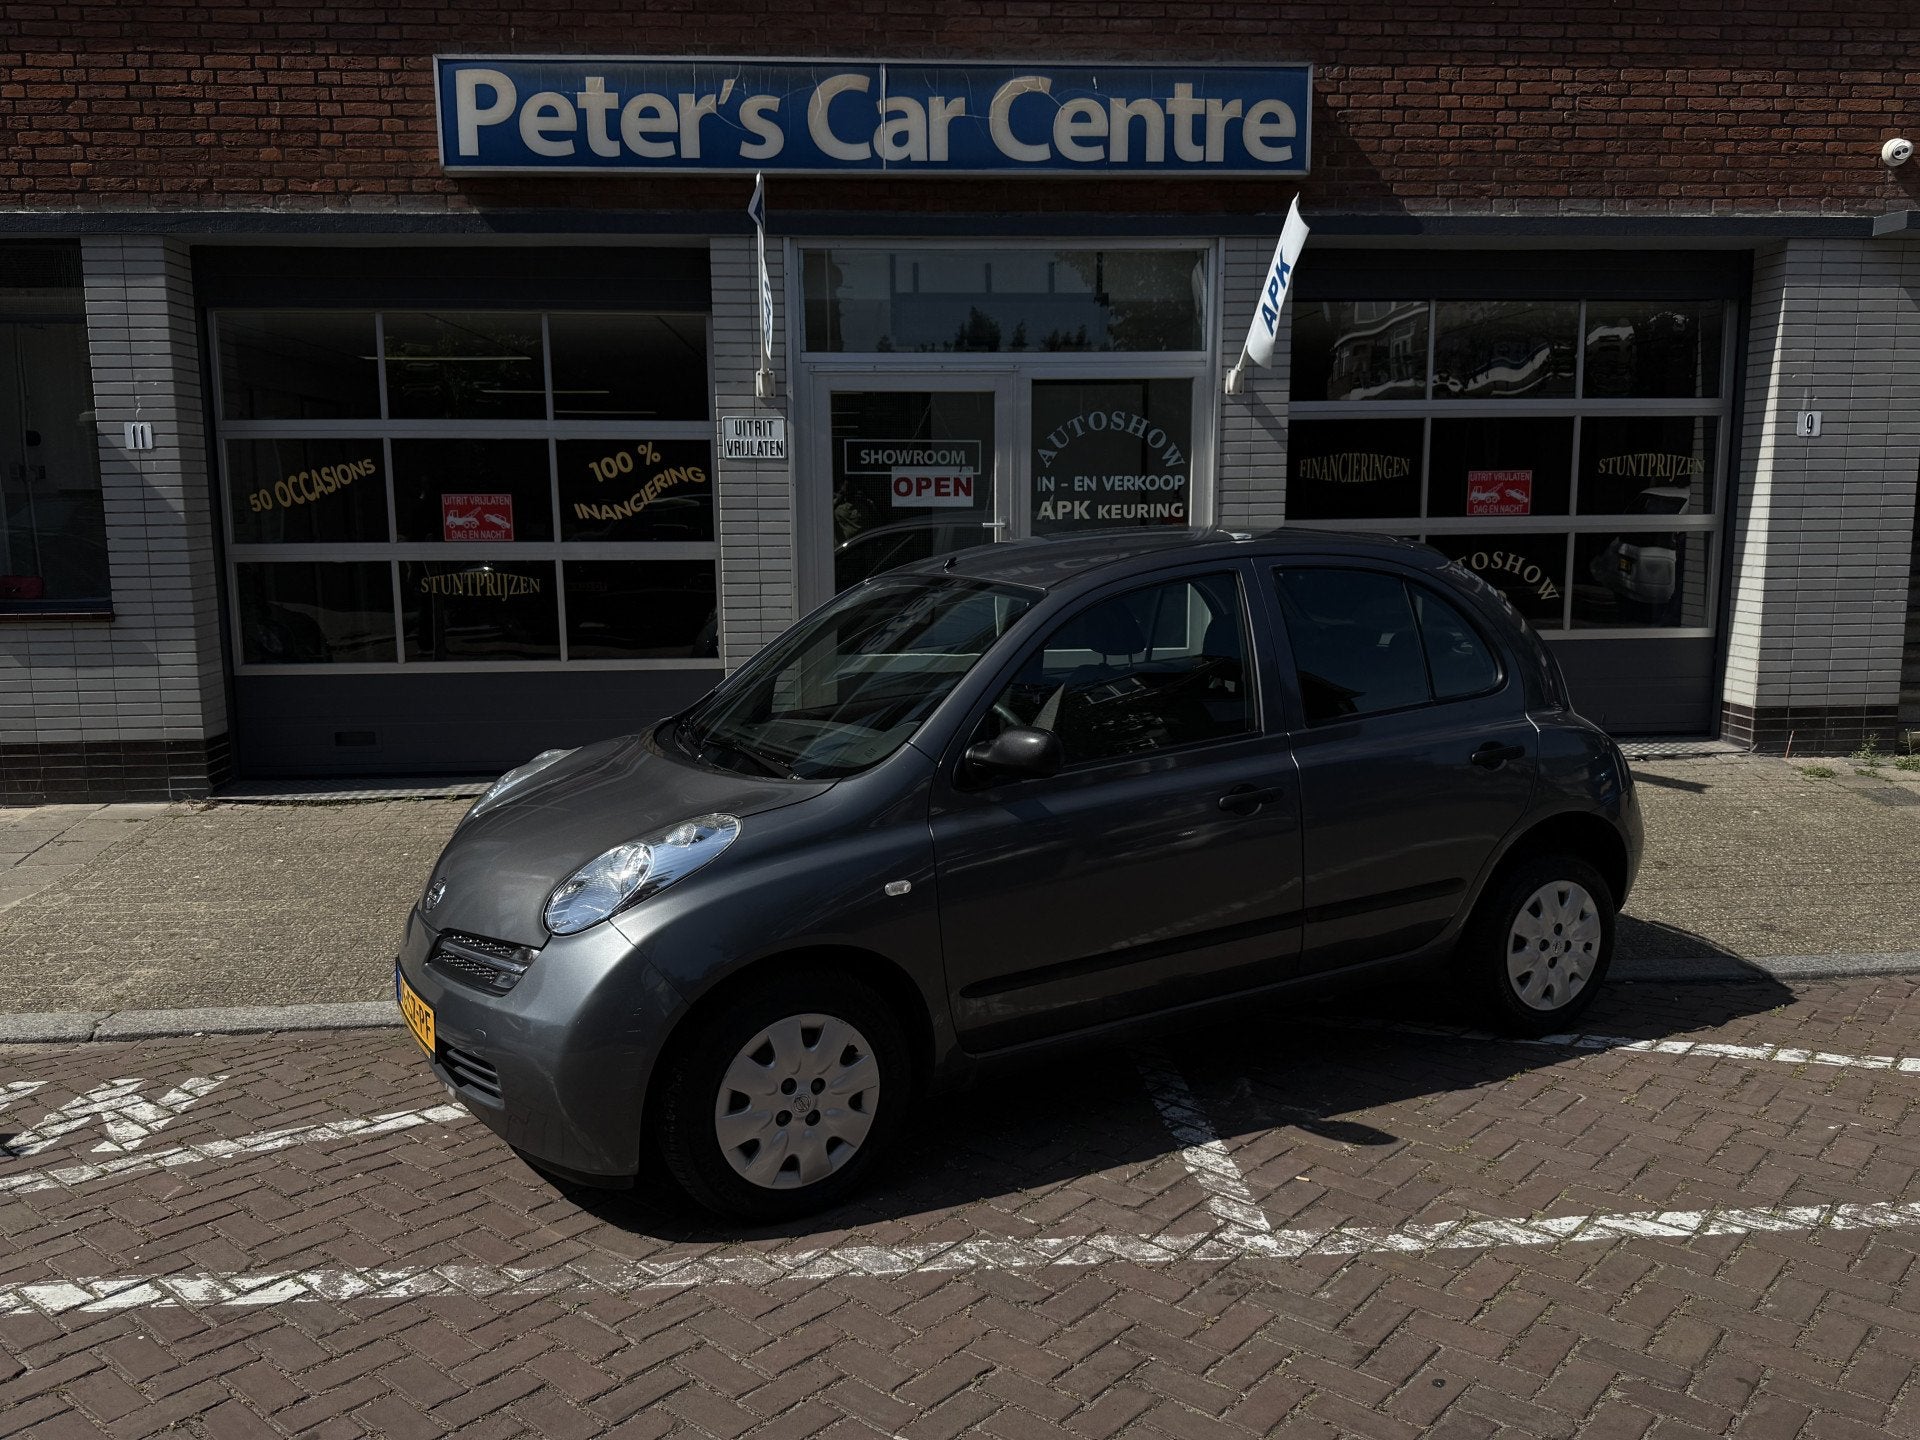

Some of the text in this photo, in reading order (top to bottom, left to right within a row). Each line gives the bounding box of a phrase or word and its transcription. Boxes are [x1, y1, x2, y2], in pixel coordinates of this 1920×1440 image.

[455, 68, 1296, 163] Peter's Car Centre
[1262, 246, 1291, 337] APK
[132, 424, 145, 448] 11
[734, 420, 773, 436] UITRIT
[1805, 413, 1814, 434] 9
[726, 440, 783, 456] VRIJLATEN
[1037, 410, 1185, 468] AUTOSHOW
[589, 441, 661, 482] 100 %
[860, 449, 966, 465] SHOWROOM
[1299, 452, 1410, 483] FINANCIERINGEN
[1597, 453, 1706, 482] STUNTPRIJZEN
[249, 458, 376, 512] 50 OCCASIONS
[893, 477, 972, 496] OPEN
[1037, 476, 1055, 492] IN
[1074, 475, 1097, 492] EN
[1102, 474, 1185, 492] VERKOOP
[1037, 500, 1184, 520] APK KEURING
[420, 571, 542, 601] STUNTPRIJZEN
[1453, 551, 1560, 600] TOSHOW
